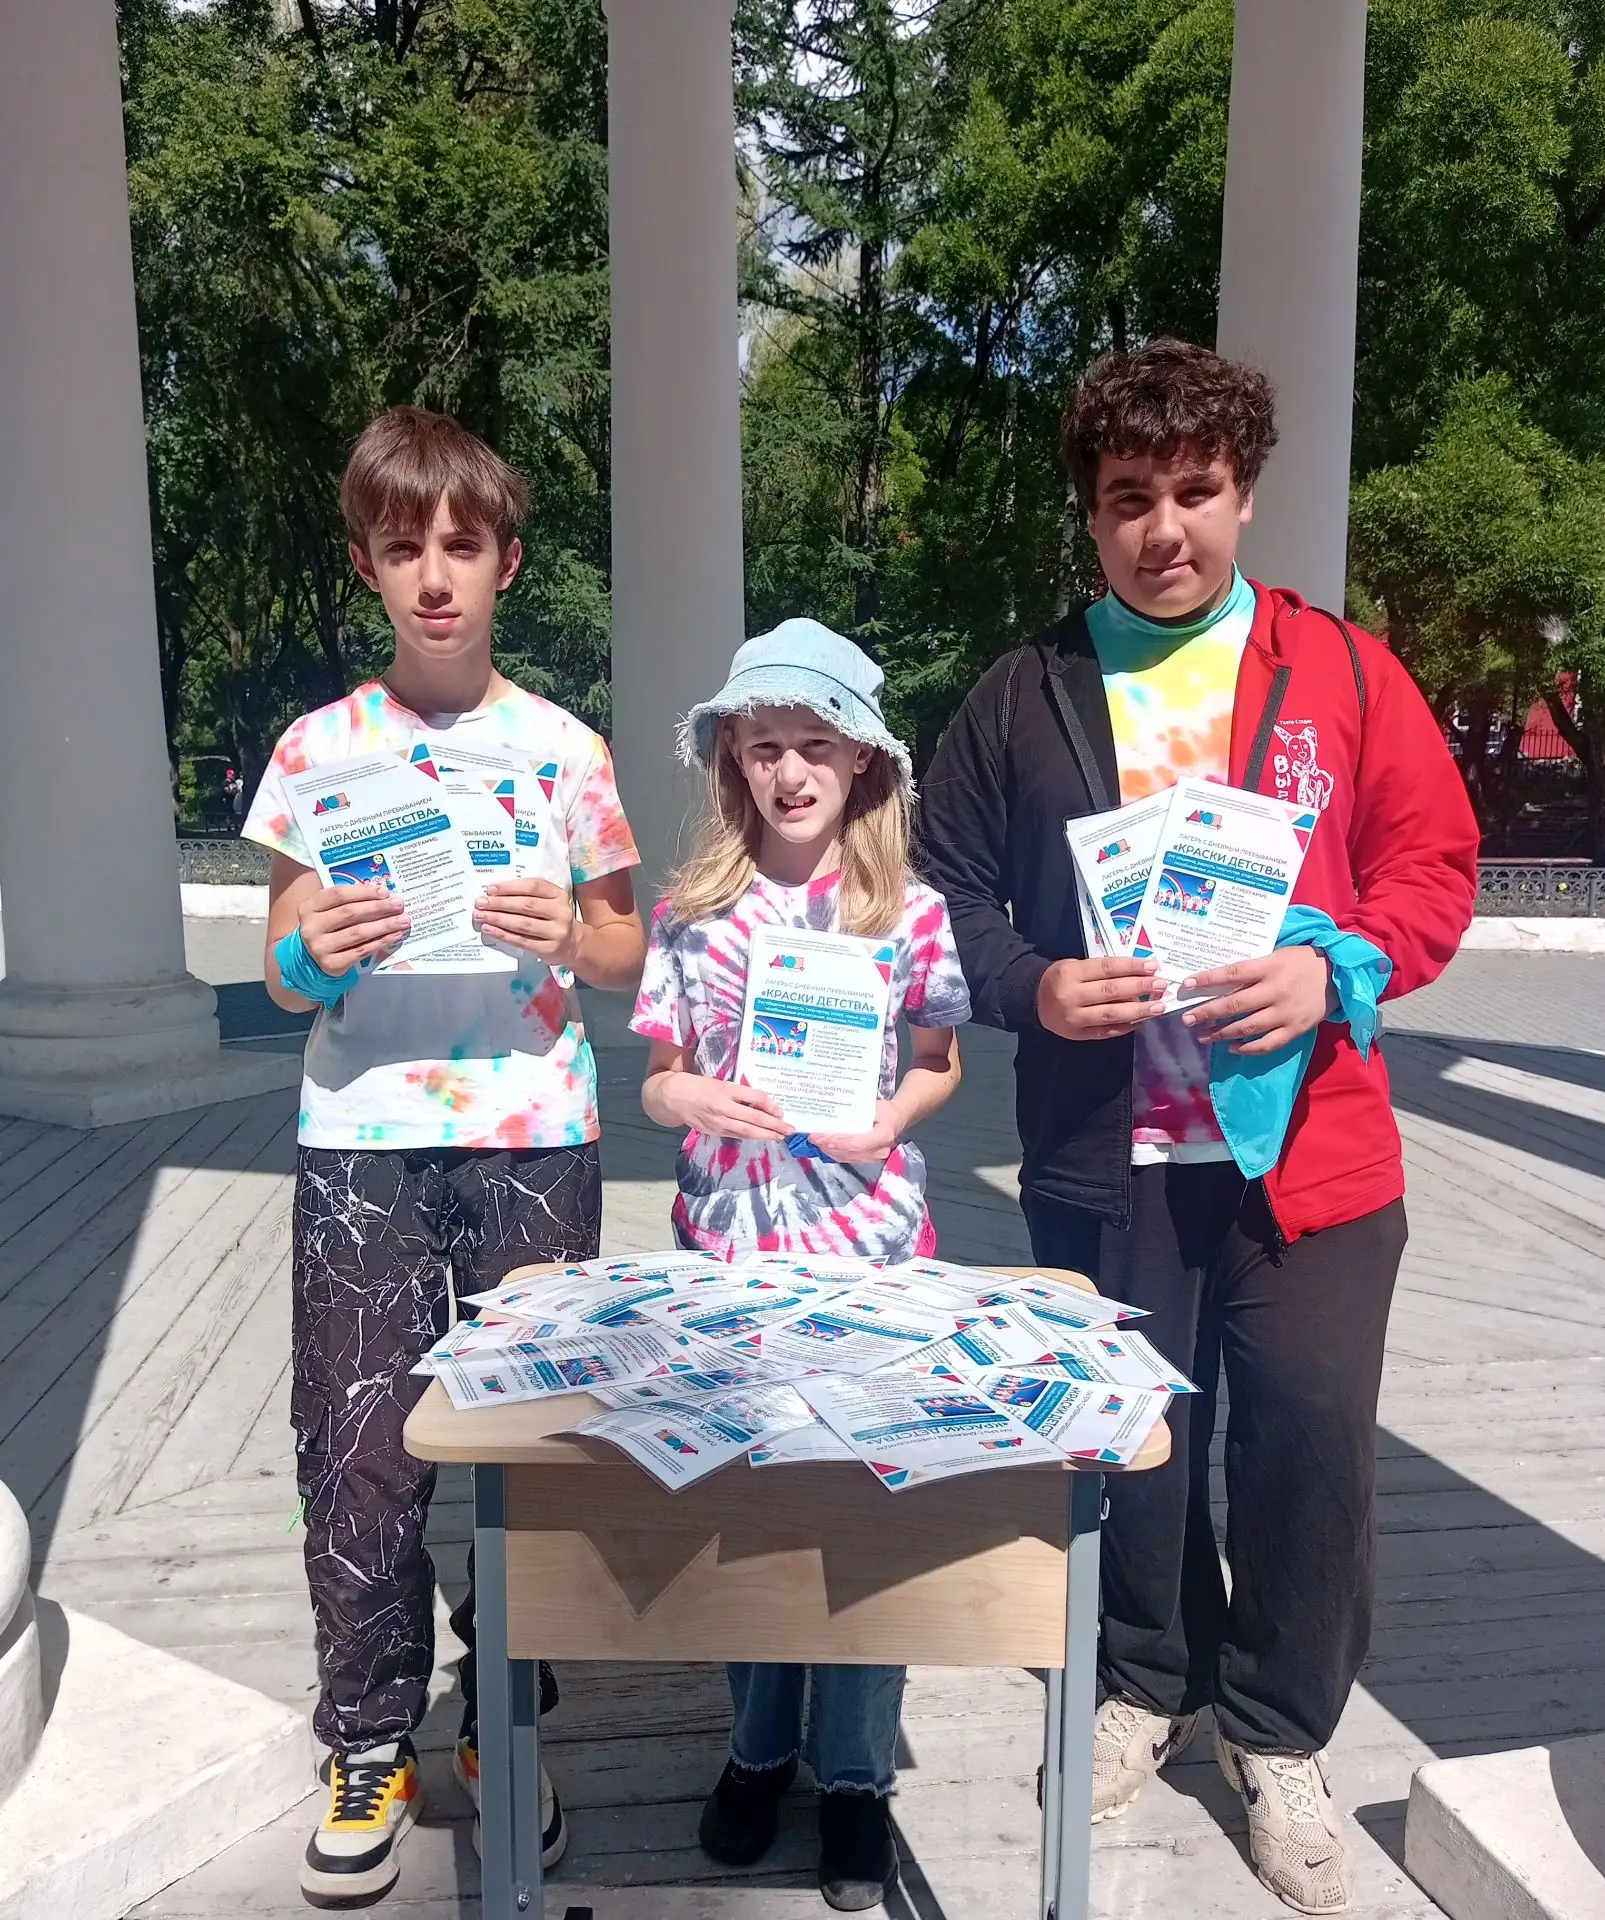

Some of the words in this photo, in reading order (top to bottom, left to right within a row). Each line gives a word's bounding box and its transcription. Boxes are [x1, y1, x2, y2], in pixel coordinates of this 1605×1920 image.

[319, 822, 343, 833] ЛАГЕРЬ
[382, 797, 432, 815] ПРЕБЫВАНИЕМ
[320, 824, 376, 847] «КРАСКИ
[377, 805, 441, 833] ДЕТСТВА»
[466, 840, 505, 849] СТВА»
[1172, 841, 1226, 862] «КРАСКИ
[1227, 856, 1286, 878] ДЕТСТВА»
[761, 988, 814, 1003] «КРАСКИ
[816, 996, 874, 1012] ДЕТСТВА»
